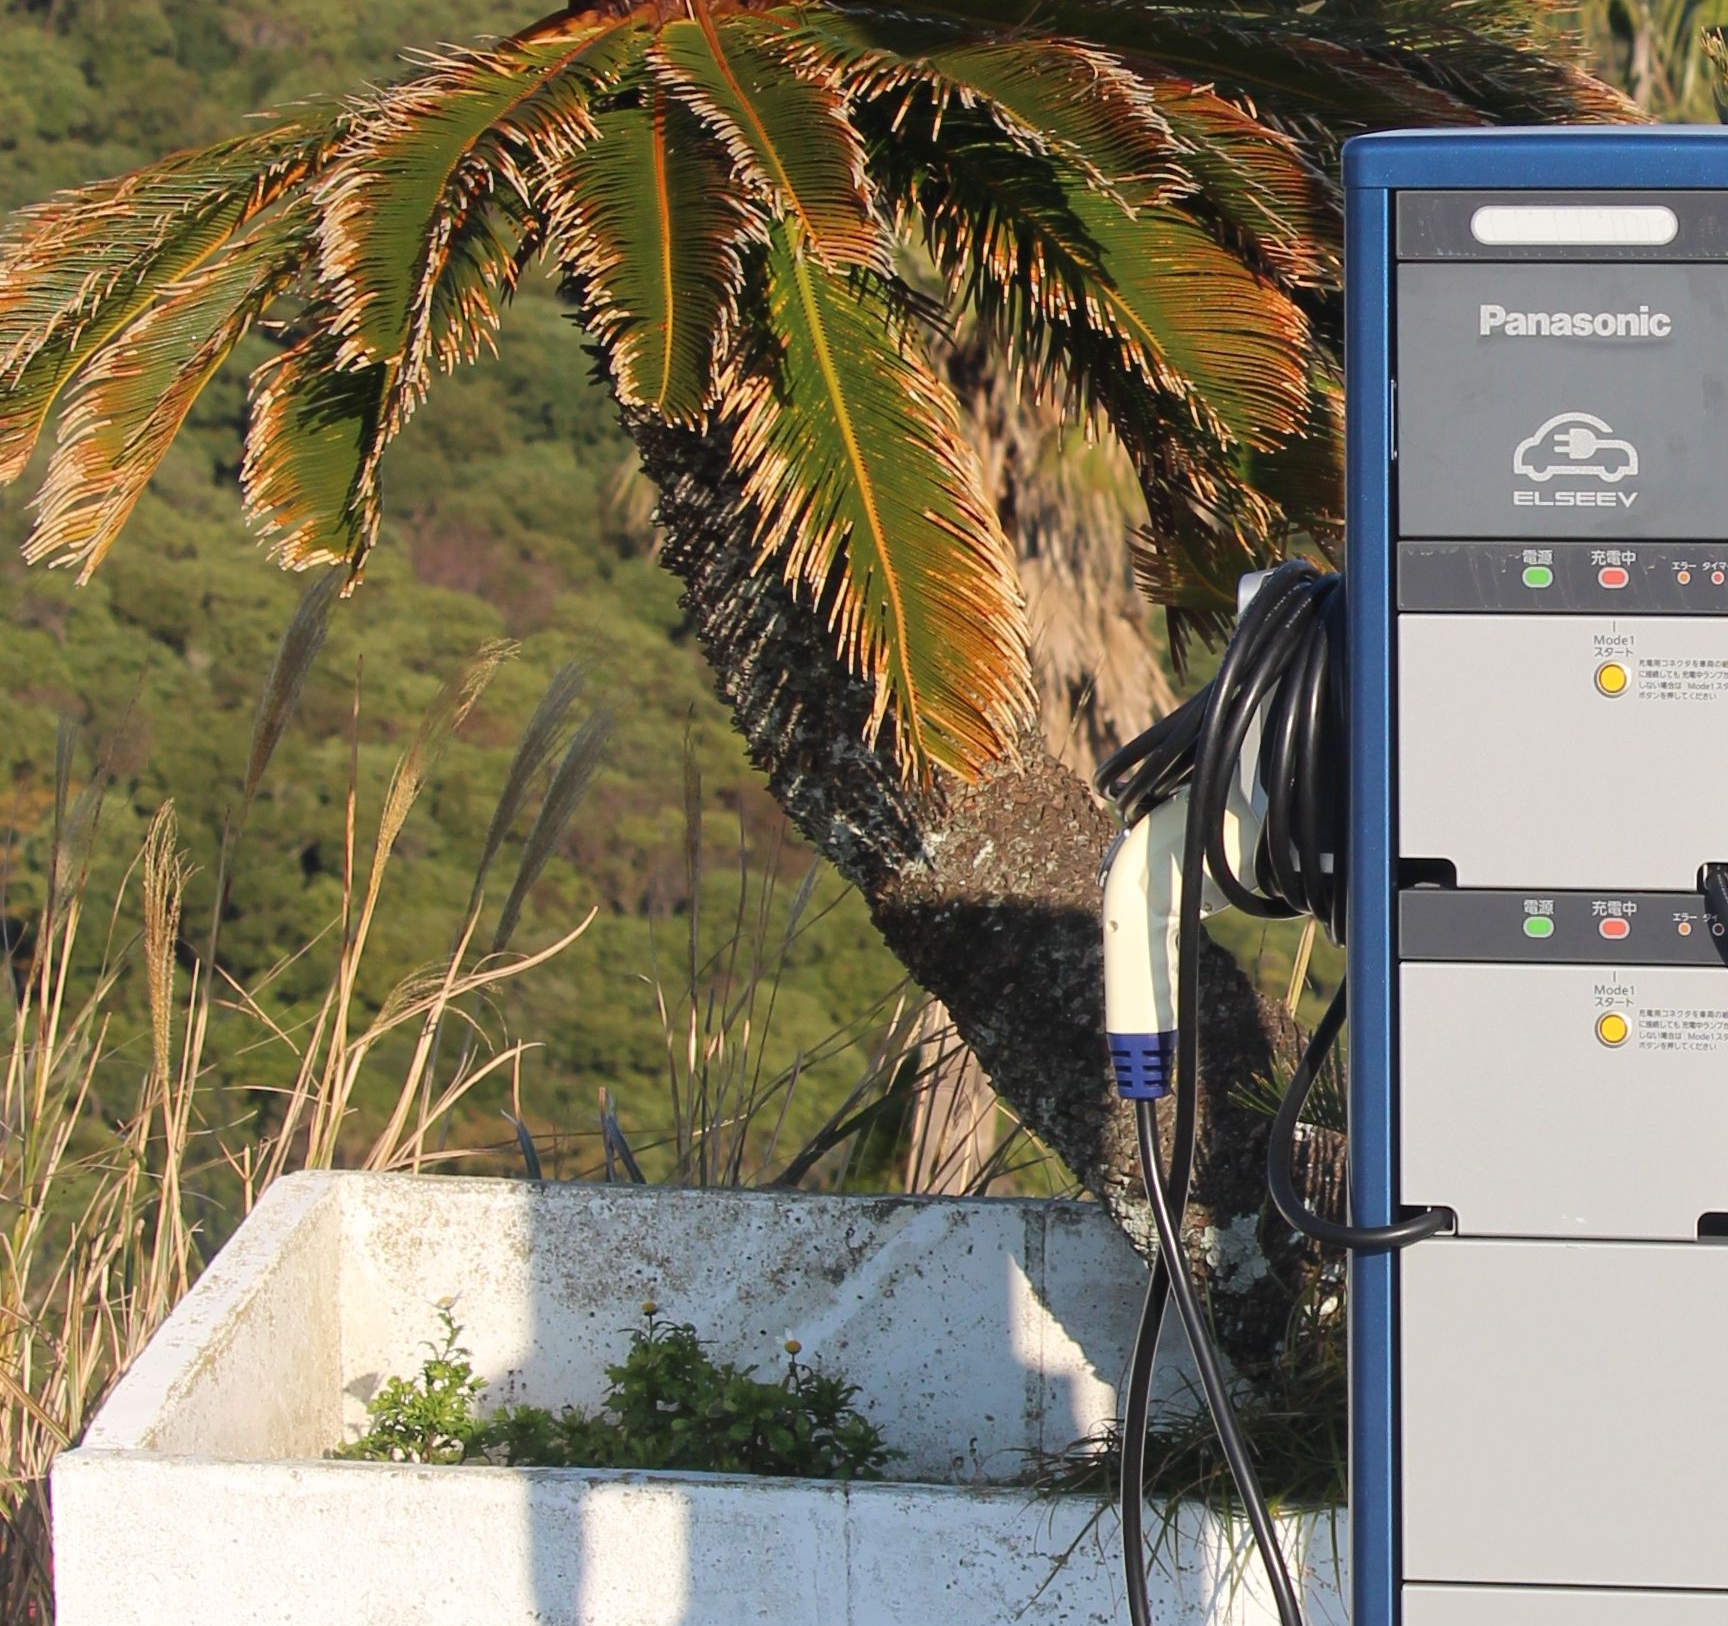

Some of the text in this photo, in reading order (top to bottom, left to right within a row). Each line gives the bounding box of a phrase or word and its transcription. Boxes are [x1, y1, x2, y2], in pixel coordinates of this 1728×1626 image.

[1480, 304, 1672, 337] Panasonic
[1513, 491, 1638, 508] ELSEEV
[1522, 549, 1554, 565] 電源
[1591, 550, 1637, 567] 充電中
[1671, 561, 1697, 571] エラー
[1593, 635, 1635, 646] Mode1
[1594, 647, 1634, 658] スタート
[1523, 899, 1554, 915] 電源
[1592, 900, 1637, 917] 充電中
[1672, 912, 1698, 922] エラー
[1593, 985, 1635, 996] Mode1
[1594, 997, 1634, 1008] スタート
